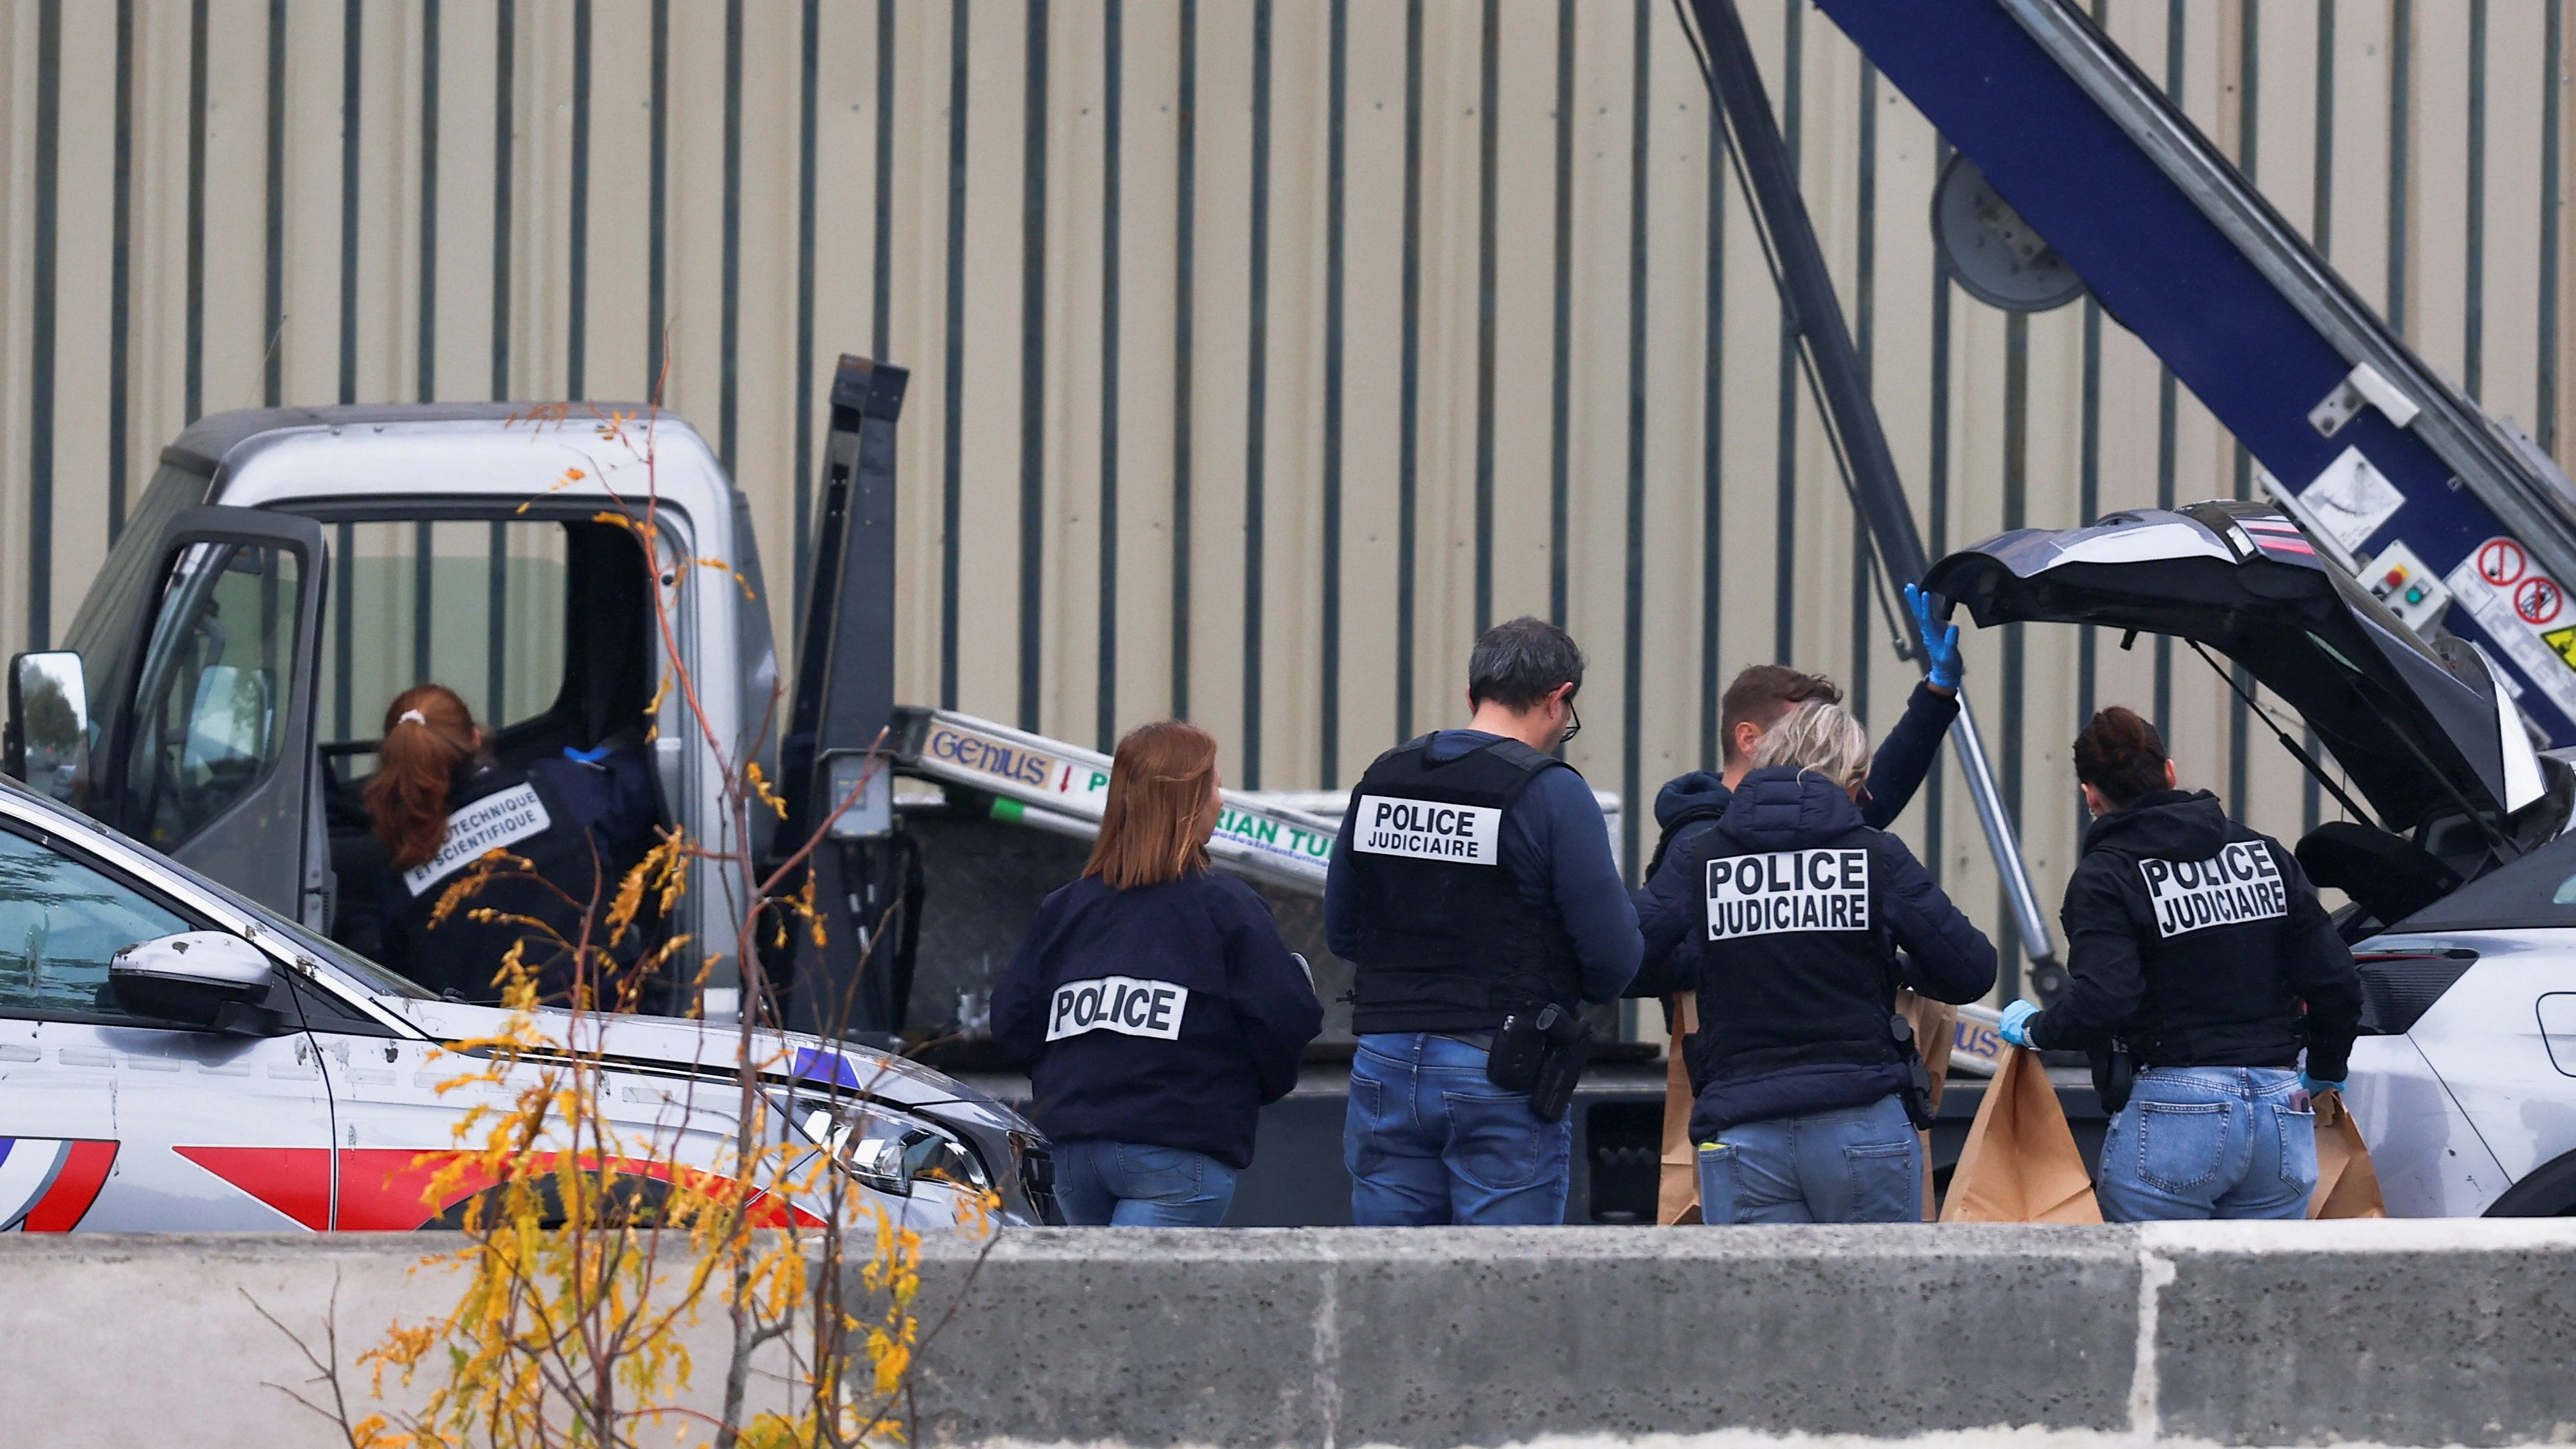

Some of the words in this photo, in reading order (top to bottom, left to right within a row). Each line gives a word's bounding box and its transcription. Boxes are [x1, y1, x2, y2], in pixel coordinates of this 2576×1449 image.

[933, 730, 1046, 785] GENIUS
[448, 791, 537, 836] TECHNIQUE
[1375, 802, 1475, 837] POLICE
[435, 809, 537, 867] SCIENTIFIQUE
[1212, 831, 1329, 867] pedestriantunne
[1289, 828, 1335, 860] TU
[1368, 831, 1479, 858] JUDICIAIRE
[1709, 851, 1865, 899] POLICE
[2142, 843, 2278, 898] POLICE
[1711, 894, 1866, 937] JUDICIAIRE
[2161, 879, 2286, 934] JUDICIAIRE
[1054, 984, 1176, 1033] POLICE
